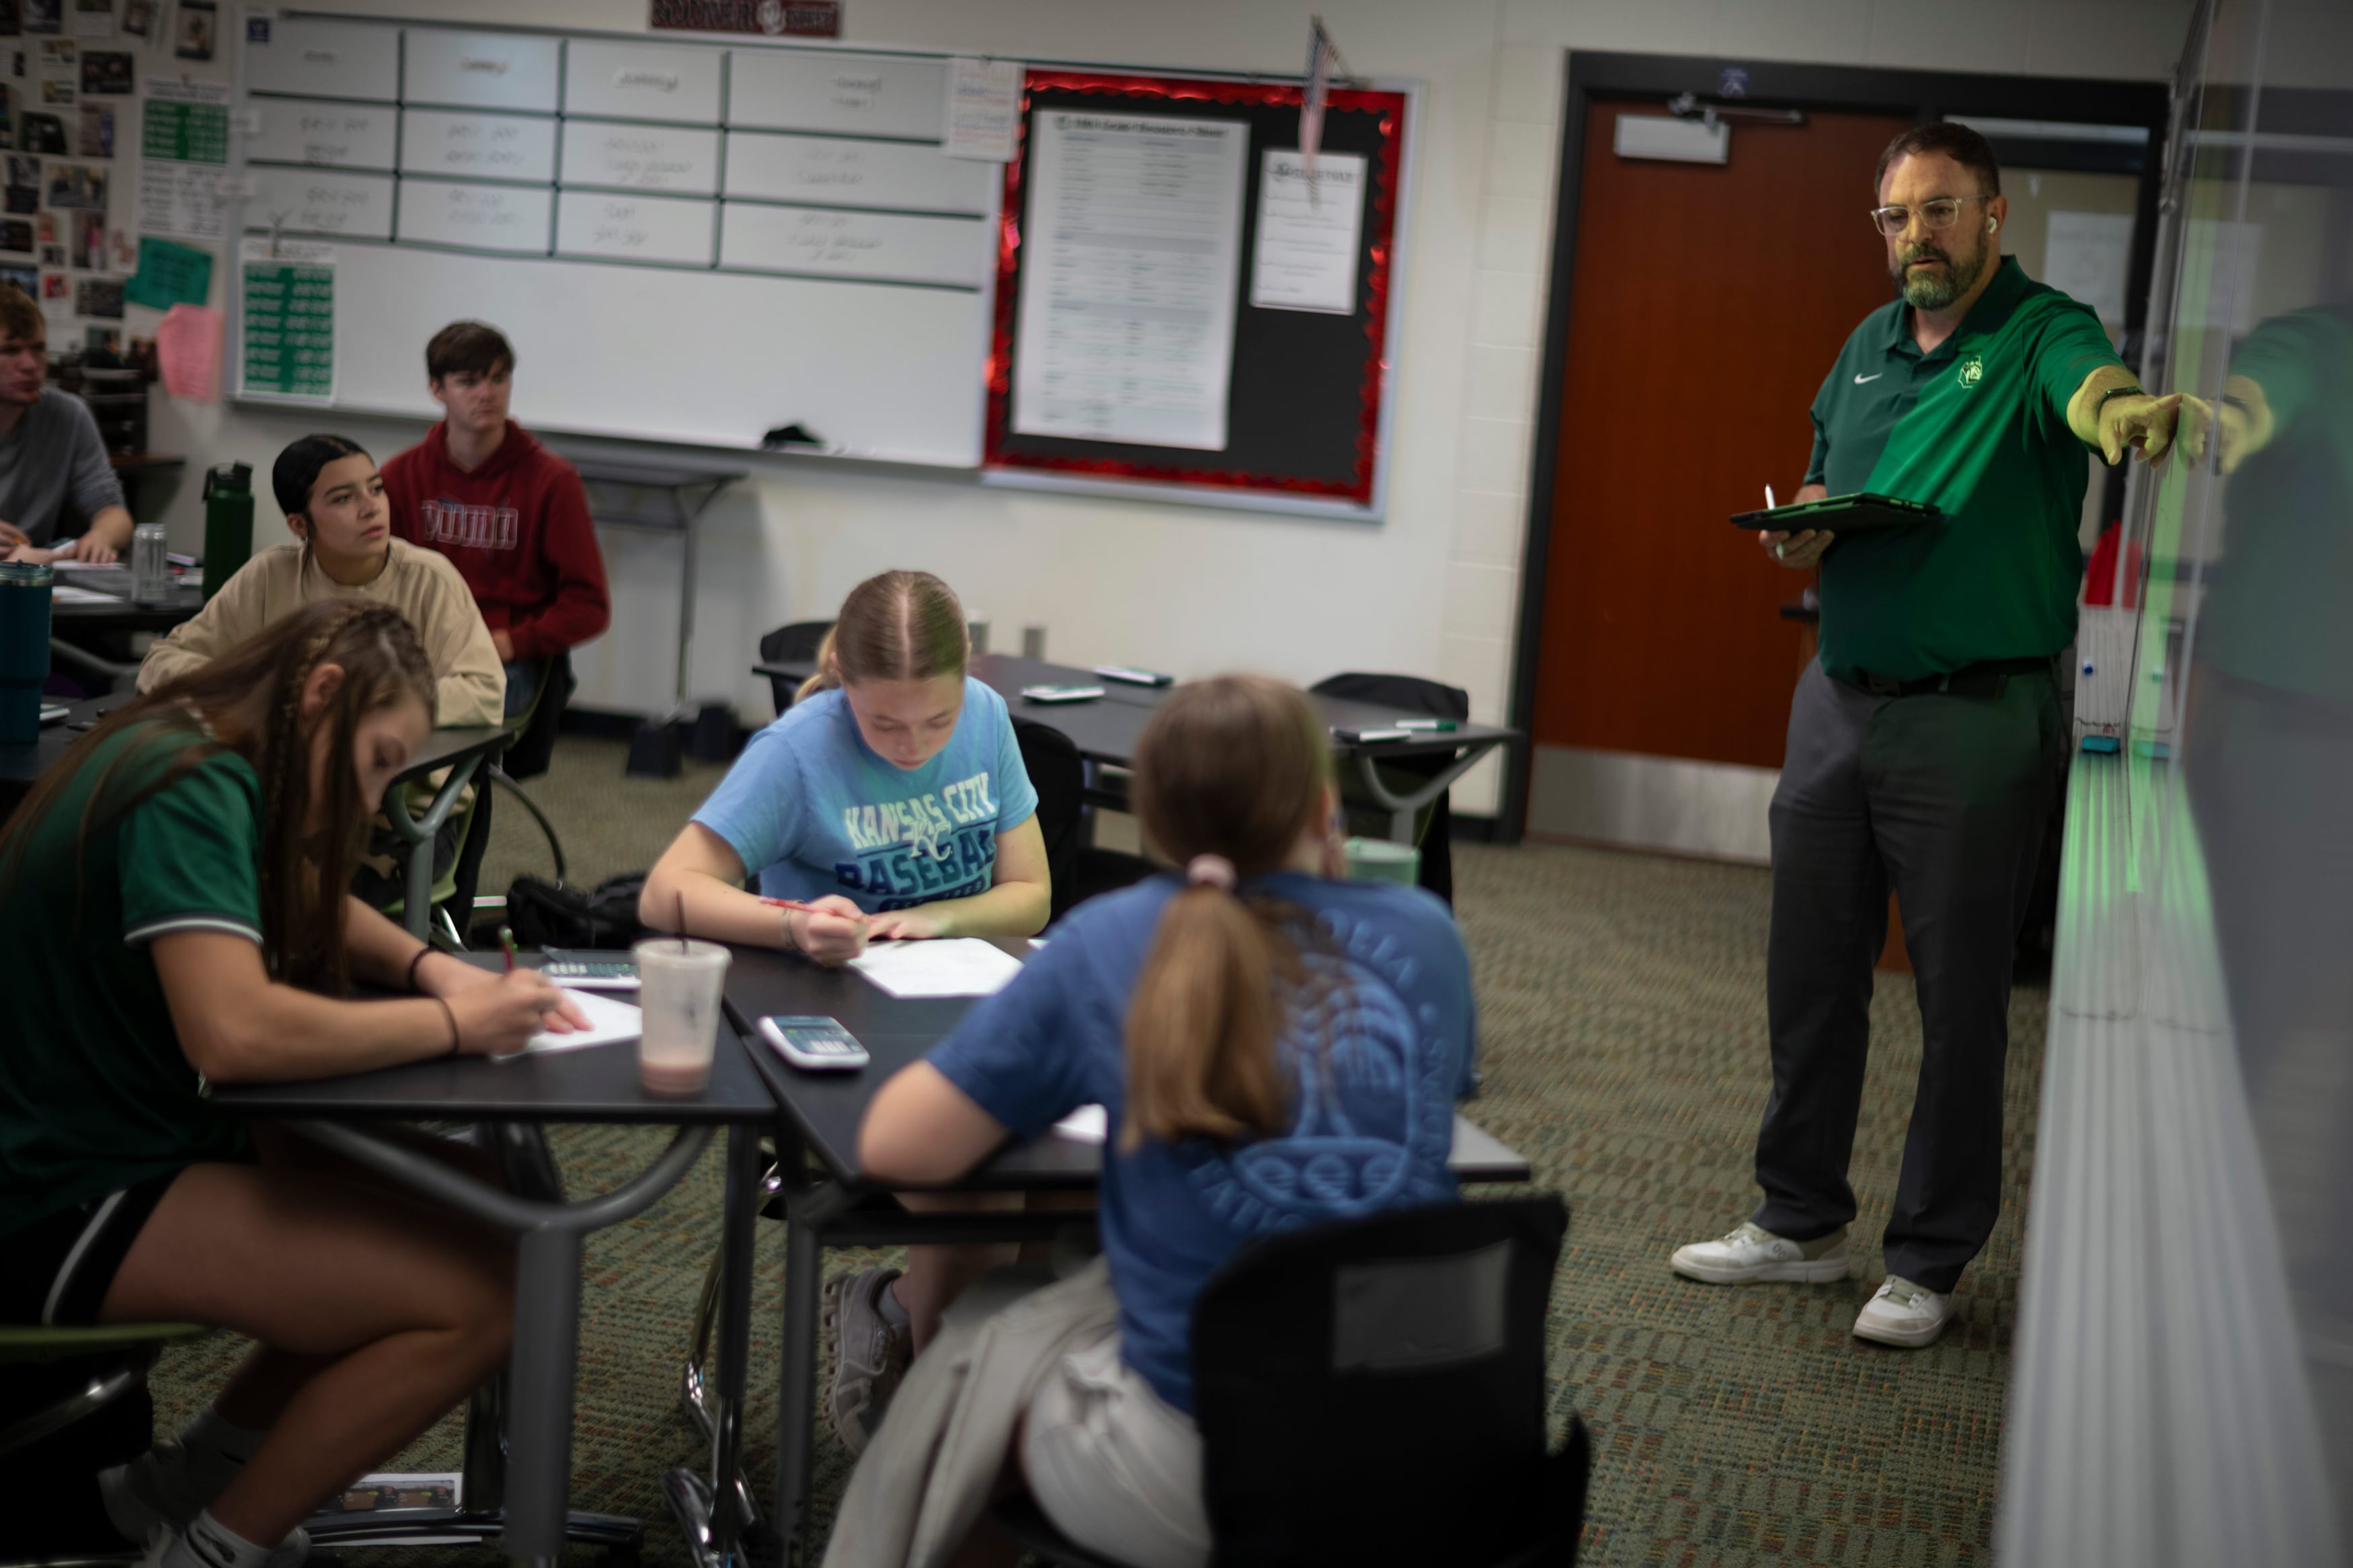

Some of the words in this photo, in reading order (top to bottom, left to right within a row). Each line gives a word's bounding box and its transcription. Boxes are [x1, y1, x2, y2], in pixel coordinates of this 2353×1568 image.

[845, 794, 948, 850] KANSAS
[943, 772, 996, 824] CITY
[910, 817, 952, 861] KC
[835, 829, 996, 896] BASEBAL
